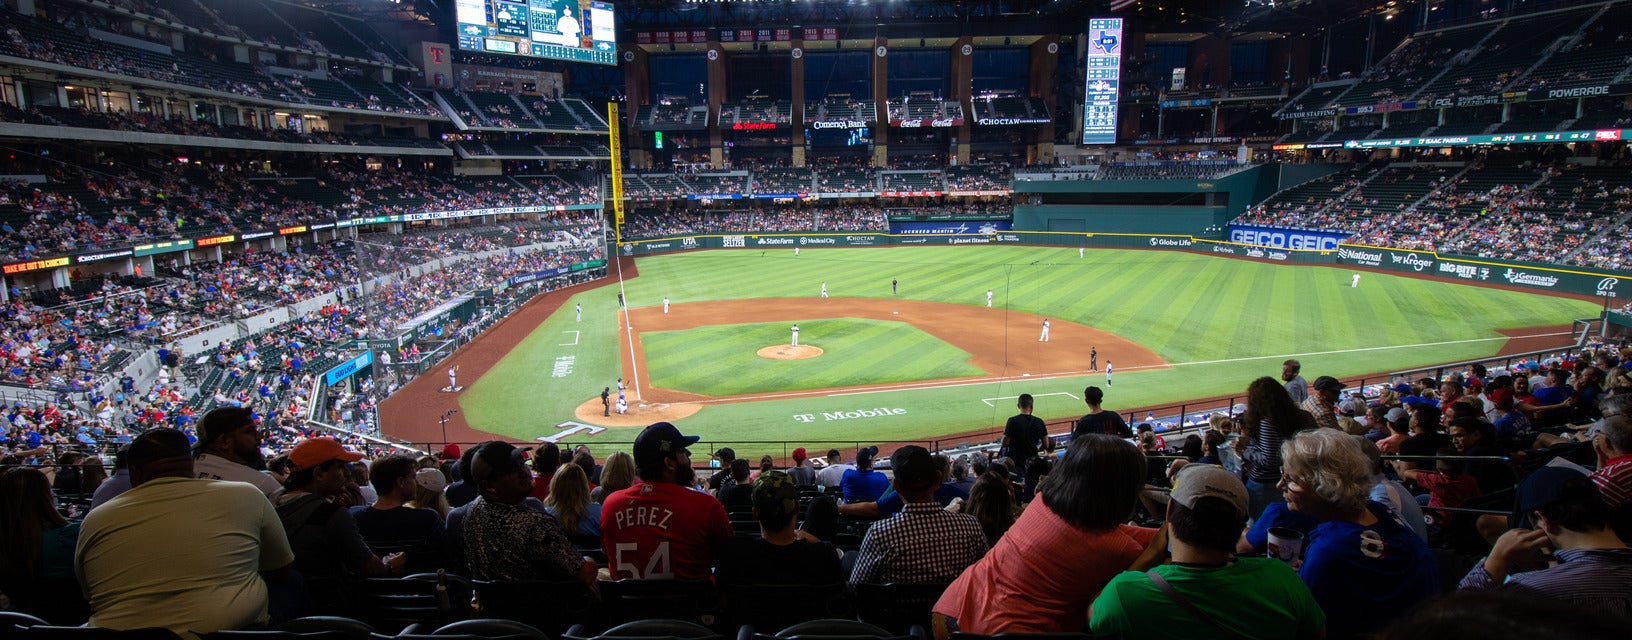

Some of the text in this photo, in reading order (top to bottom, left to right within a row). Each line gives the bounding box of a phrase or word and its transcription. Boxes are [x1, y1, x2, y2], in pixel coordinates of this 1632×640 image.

[429, 46, 444, 64] T
[1549, 86, 1609, 98] POWERADE
[1231, 230, 1285, 248] GEICO
[1347, 250, 1382, 261] National
[1404, 253, 1433, 271] Kroger
[2, 265, 18, 274] TAKE
[39, 262, 45, 270] TO
[1440, 263, 1477, 275] BIG BITE
[1519, 272, 1559, 284] Germania
[335, 370, 344, 379] BUD
[793, 408, 907, 423] T Mobile
[534, 421, 608, 443] T
[615, 500, 673, 530] PÉREZ
[616, 541, 674, 579] 54
